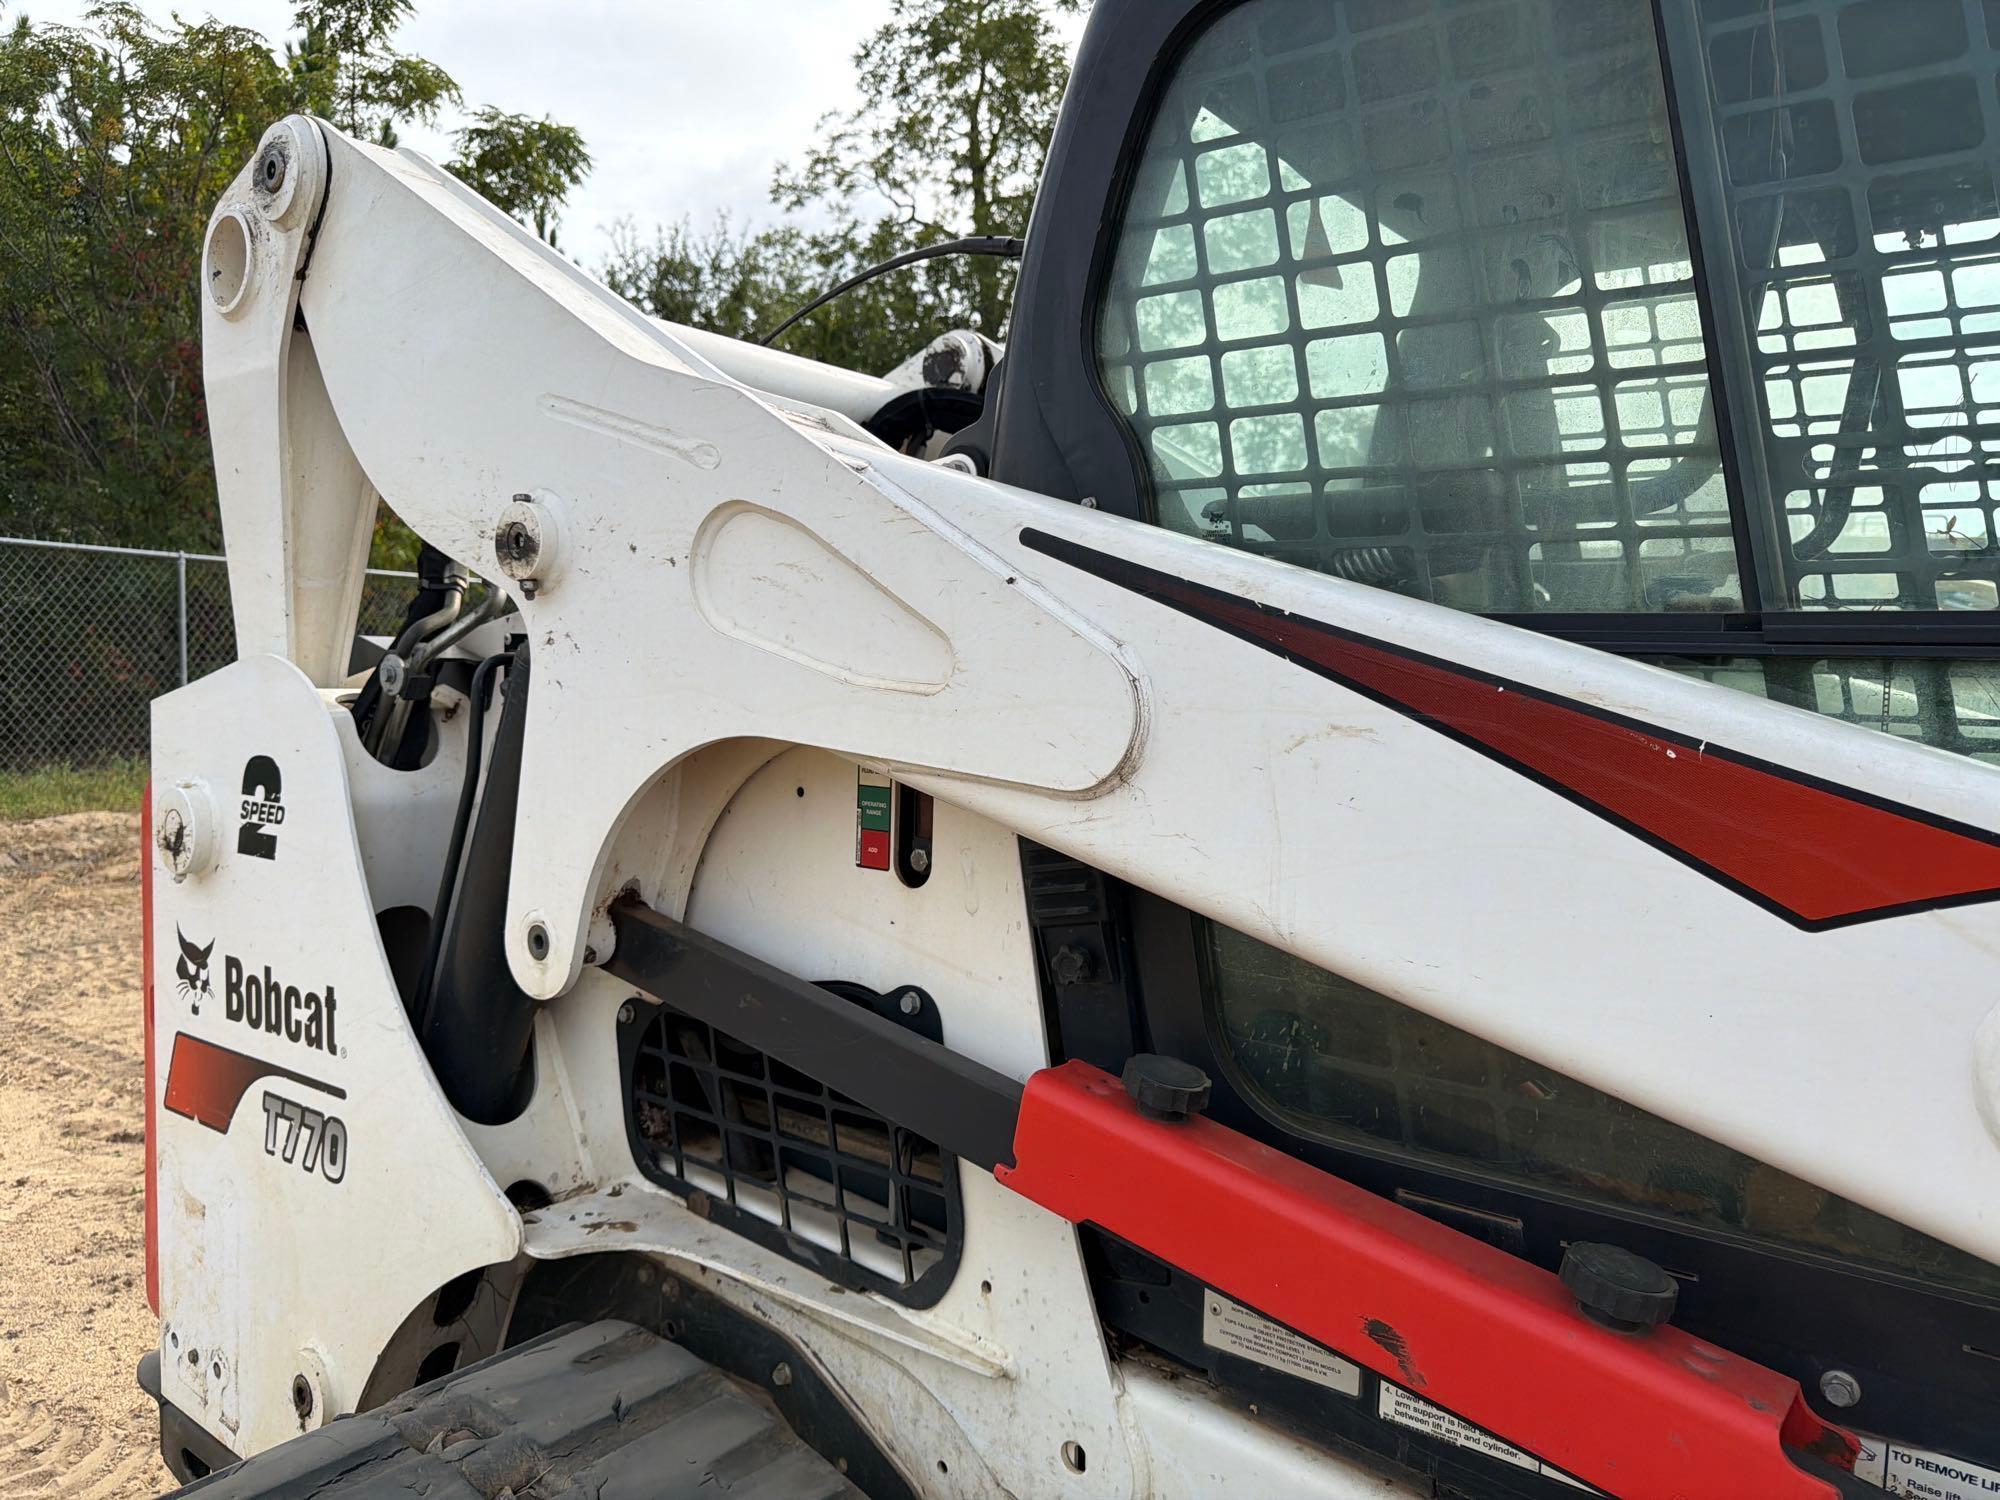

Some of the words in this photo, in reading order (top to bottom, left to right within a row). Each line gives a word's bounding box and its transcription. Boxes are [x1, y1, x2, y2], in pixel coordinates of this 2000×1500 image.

[240, 800, 285, 825] SPEED
[861, 800, 887, 809] OPERATING
[225, 954, 337, 1056] Bobcat
[263, 1090, 347, 1184] T770
[1237, 1322, 1257, 1333] FALLING
[1257, 1329, 1276, 1339] OBJECT
[1276, 1335, 1306, 1349] PROTECTIVE
[1220, 1329, 1243, 1341] CERTIFIED
[1275, 1348, 1299, 1359] COMPACT
[1300, 1357, 1320, 1367] LOADER
[1320, 1363, 1342, 1375] MODELS
[1245, 1344, 1268, 1356] MAXIMUM
[1286, 1346, 1301, 1354] LEVEL
[1384, 1386, 1393, 1395] 4.
[1395, 1389, 1420, 1404] Lower
[1395, 1400, 1411, 1410] arm
[1413, 1406, 1446, 1423] support
[1447, 1417, 1455, 1426] is
[1457, 1420, 1476, 1434] held
[1394, 1407, 1430, 1427] between
[1432, 1421, 1443, 1432] lift
[1445, 1427, 1462, 1438] arm
[1463, 1434, 1481, 1446] and
[1482, 1440, 1521, 1460] cylinder.
[1892, 1450, 1912, 1464] TO
[1915, 1457, 1979, 1486] REMOVE
[1891, 1474, 1902, 1485] 1.
[1907, 1479, 1942, 1497] Raise
